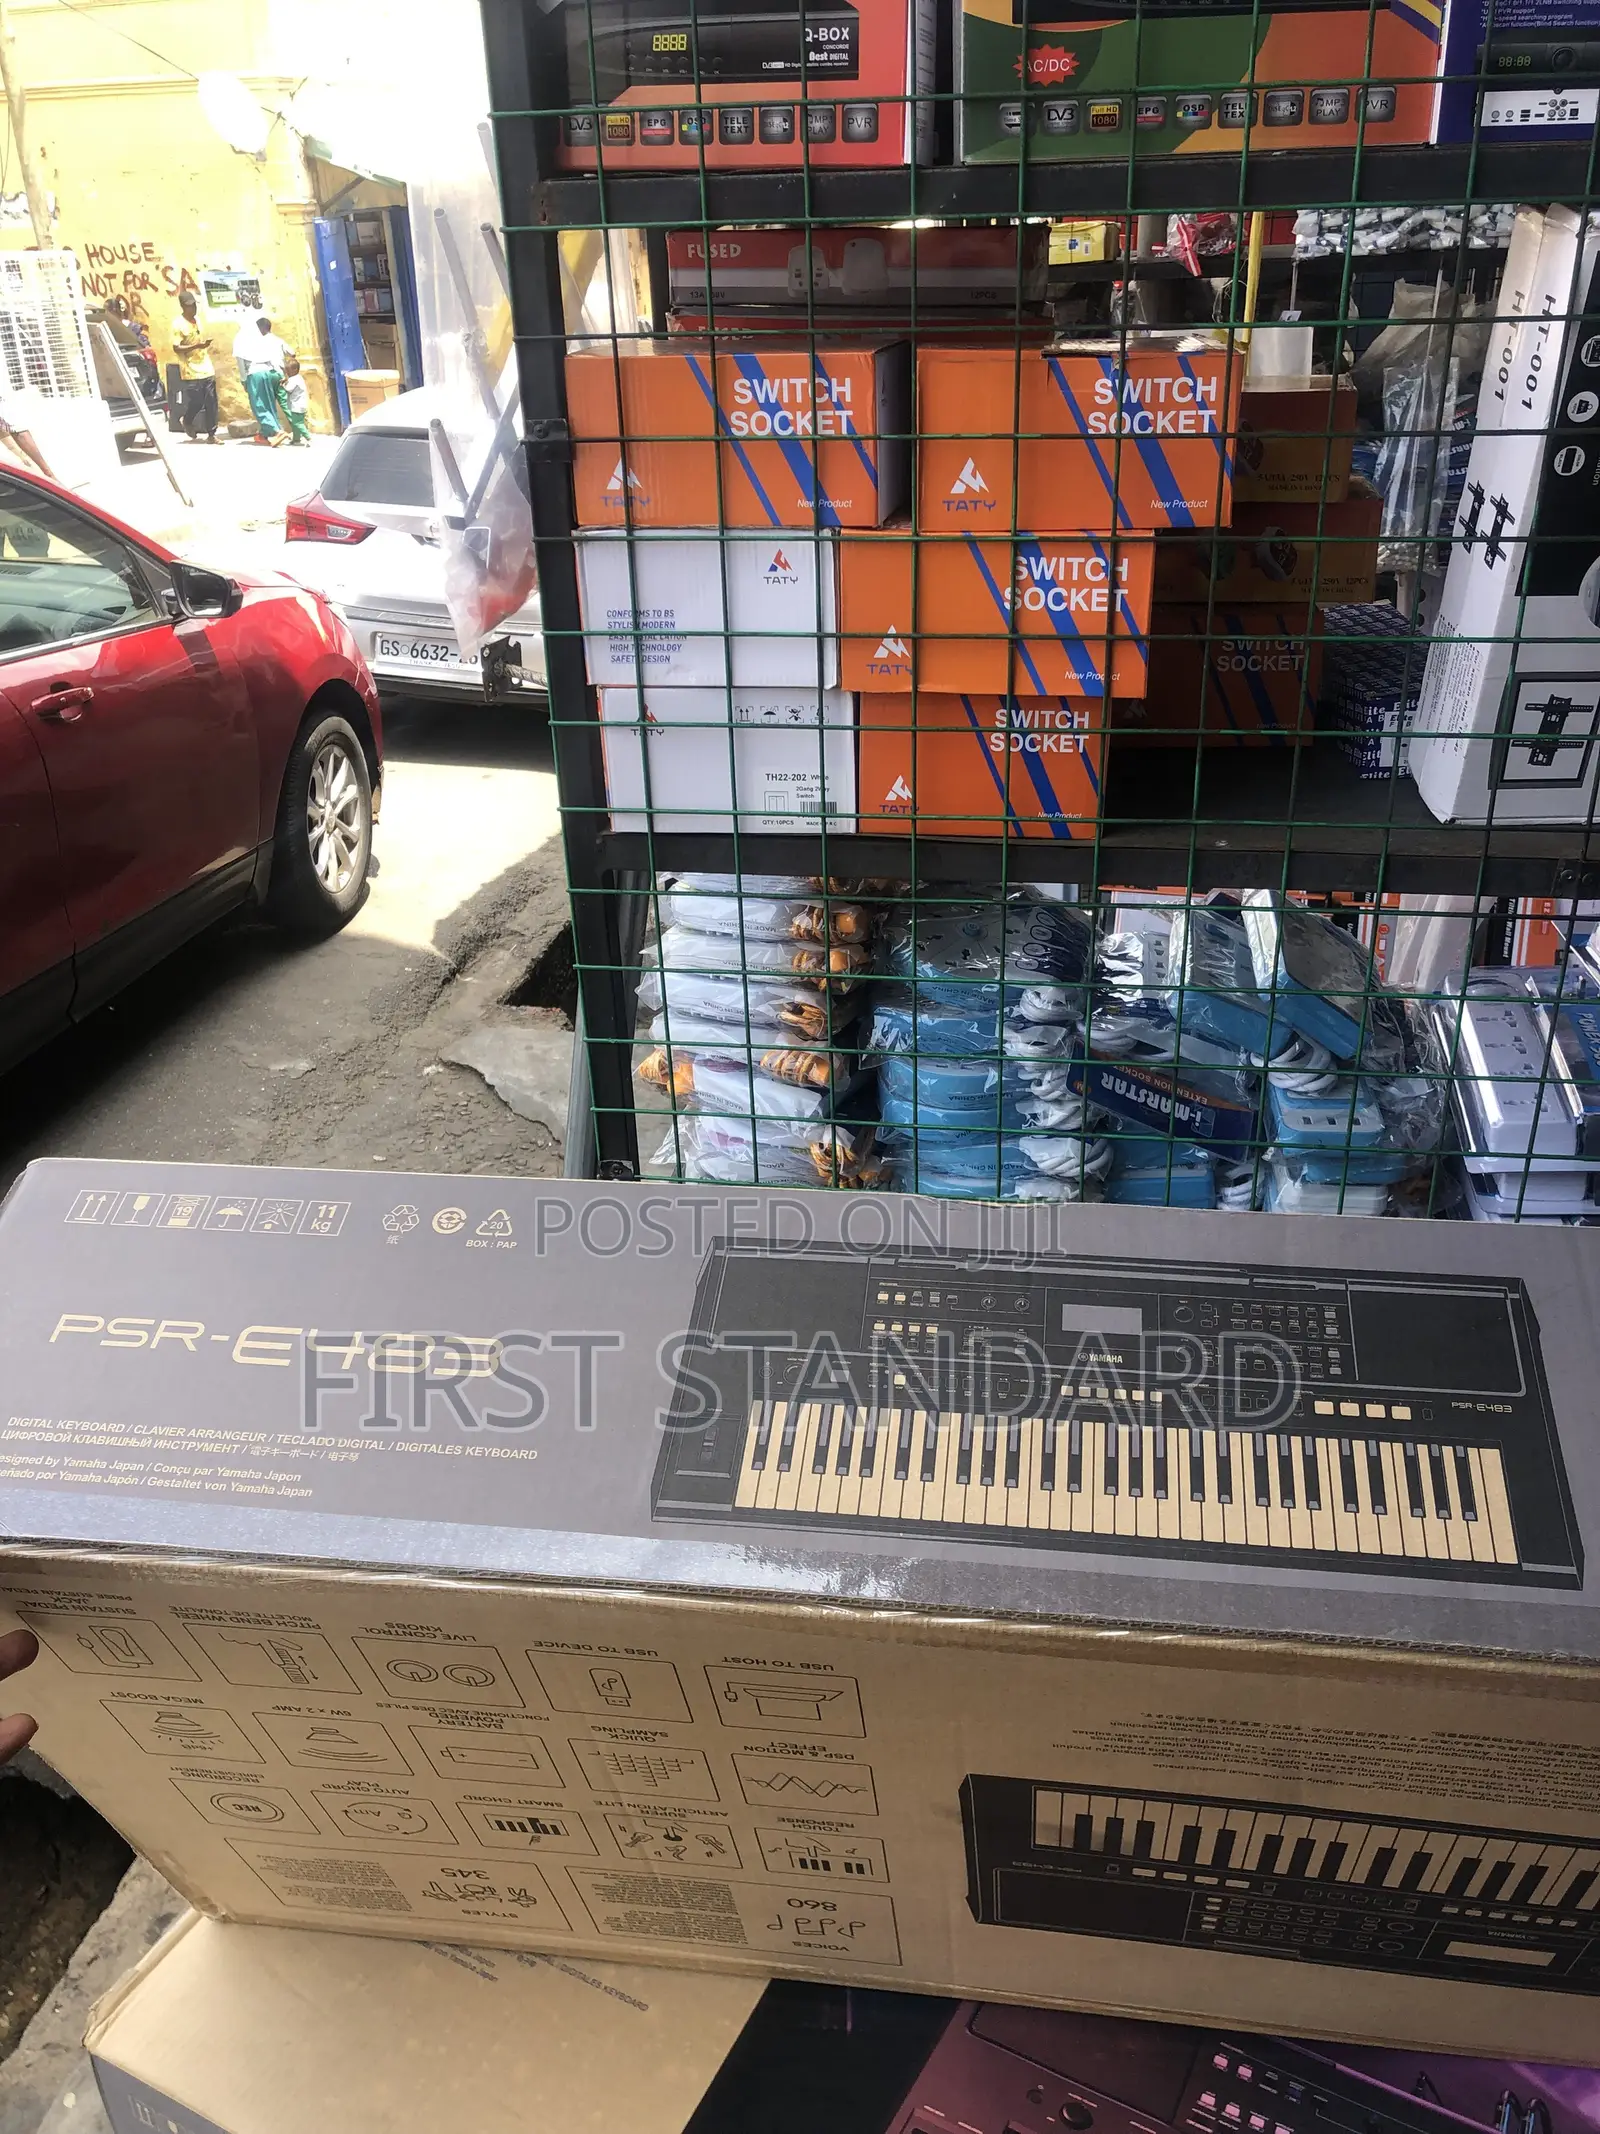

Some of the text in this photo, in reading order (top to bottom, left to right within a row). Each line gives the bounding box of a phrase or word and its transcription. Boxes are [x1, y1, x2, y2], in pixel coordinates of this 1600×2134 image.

[808, 51, 829, 61] Best
[1105, 105, 1118, 113] HD
[1137, 106, 1160, 116] EPG
[1182, 103, 1205, 113] OSD
[1316, 108, 1342, 117] PLAY
[647, 118, 667, 127] EPG
[723, 116, 748, 125] TELE
[847, 115, 873, 129] PVR
[1092, 114, 1117, 126] 1080
[607, 126, 630, 138] 1080
[723, 125, 750, 135] TEXT
[85, 242, 155, 269] HOUSE
[687, 243, 742, 258] FUSED
[81, 272, 117, 298] NOT
[1521, 293, 1557, 412] HT-001
[732, 376, 852, 405] SWITCH
[1093, 375, 1218, 405] SWITCH
[729, 409, 854, 437] SOCKET
[1087, 409, 1217, 435] SOCKET
[600, 495, 652, 508] TATY
[817, 498, 853, 509] Product
[941, 499, 997, 512] TATY
[1150, 498, 1209, 510] New Product
[1013, 556, 1129, 582] SWITCH
[762, 576, 799, 585] TATY
[1003, 587, 1129, 613] SOCKET
[606, 609, 675, 619] CONFOMS TO BS
[642, 621, 676, 629] MODERN
[380, 640, 400, 657] GS
[609, 644, 683, 653] HIGH TCHNOLOGY
[642, 655, 671, 664] DESIGN
[1216, 654, 1305, 673] SOCKET
[1064, 671, 1085, 681] New
[994, 708, 1091, 730] SWITCH
[989, 732, 1090, 754] SOCKET
[764, 773, 807, 782] TH22-202
[1054, 811, 1083, 820] Product
[931, 985, 959, 996] CHINA
[1154, 1078, 1208, 1105] EXTENION
[1100, 1072, 1203, 1127] i-MARSTAR
[176, 1205, 193, 1216] 19
[317, 1205, 338, 1218] 11
[309, 1218, 331, 1234] kg
[489, 1220, 504, 1230] 20
[465, 1239, 517, 1249] BOX PAP
[48, 1313, 504, 1378] PSR-E483
[1088, 1353, 1124, 1364] YAMAHA
[1450, 1401, 1514, 1414] PSR-E483
[1, 1429, 71, 1444] ЦИФРОВОЙ
[72, 1434, 152, 1449] КЛАВИШНЫЙ
[153, 1439, 240, 1455] ИНСТРУМЕНТ
[7, 1416, 539, 1461] DIGITAL KEYBOARD CLAVIER ARRANGEUR TECLADO DIGITAL DIGITALES KEYBOARD
[45, 1456, 60, 1468] by
[63, 1457, 107, 1470] Yamaha
[109, 1459, 145, 1473] Japan
[154, 1463, 192, 1476] Conçu
[194, 1467, 215, 1477] par
[216, 1467, 263, 1480] Yamaha
[264, 1470, 302, 1483] Japon
[35, 1470, 57, 1481] por
[58, 1472, 101, 1485] Yamaha
[103, 1474, 139, 1488] Japón
[147, 1477, 201, 1490] Gestaltet
[204, 1482, 227, 1492] von
[230, 1482, 275, 1496] Yamaha
[276, 1485, 313, 1498] Japan
[48, 1589, 103, 1600] SUSTAIN
[50, 1596, 90, 1605] JACK
[22, 1600, 137, 1616] SUSTAIN PEDAL
[174, 1610, 322, 1631] PITCH BEND WHEEL
[385, 1621, 443, 1633] KNOBS
[358, 1626, 477, 1643] LIVE CONTROL
[533, 1640, 659, 1657] USB TO DEVICE
[722, 1655, 835, 1672] USB TO HOST
[109, 1690, 205, 1705] MEGA BOOST
[271, 1704, 302, 1713] AMP
[330, 1709, 353, 1717] 6W
[375, 1701, 551, 1722] FONCTIONNE AVEC DES PILES
[428, 1711, 505, 1724] POWERED
[437, 1718, 504, 1730] BATTERY
[590, 1725, 669, 1738] SAMPLING
[610, 1732, 657, 1743] QUICK
[743, 1745, 805, 1757] MOTION
[769, 1741, 828, 1752] EFFECT
[824, 1752, 855, 1761] DSP
[179, 1770, 261, 1784] RECORDING
[322, 1783, 410, 1796] AUTO CHORD
[346, 1779, 380, 1789] PLAY
[463, 1794, 564, 1808] SMART CHORD
[231, 1803, 263, 1813] REC
[353, 1808, 382, 1818] Am
[593, 1799, 729, 1818] ARTICULATION LITE
[639, 1809, 687, 1819] SUPER
[776, 1816, 855, 1829] RESPONSE
[791, 1823, 841, 1833] TOUCH
[440, 1867, 490, 1880] 345
[786, 1897, 838, 1912] 860
[461, 1909, 519, 1919] STYLES
[792, 1940, 850, 1952] VOICES
[603, 1985, 650, 2013] KEYBOARD
